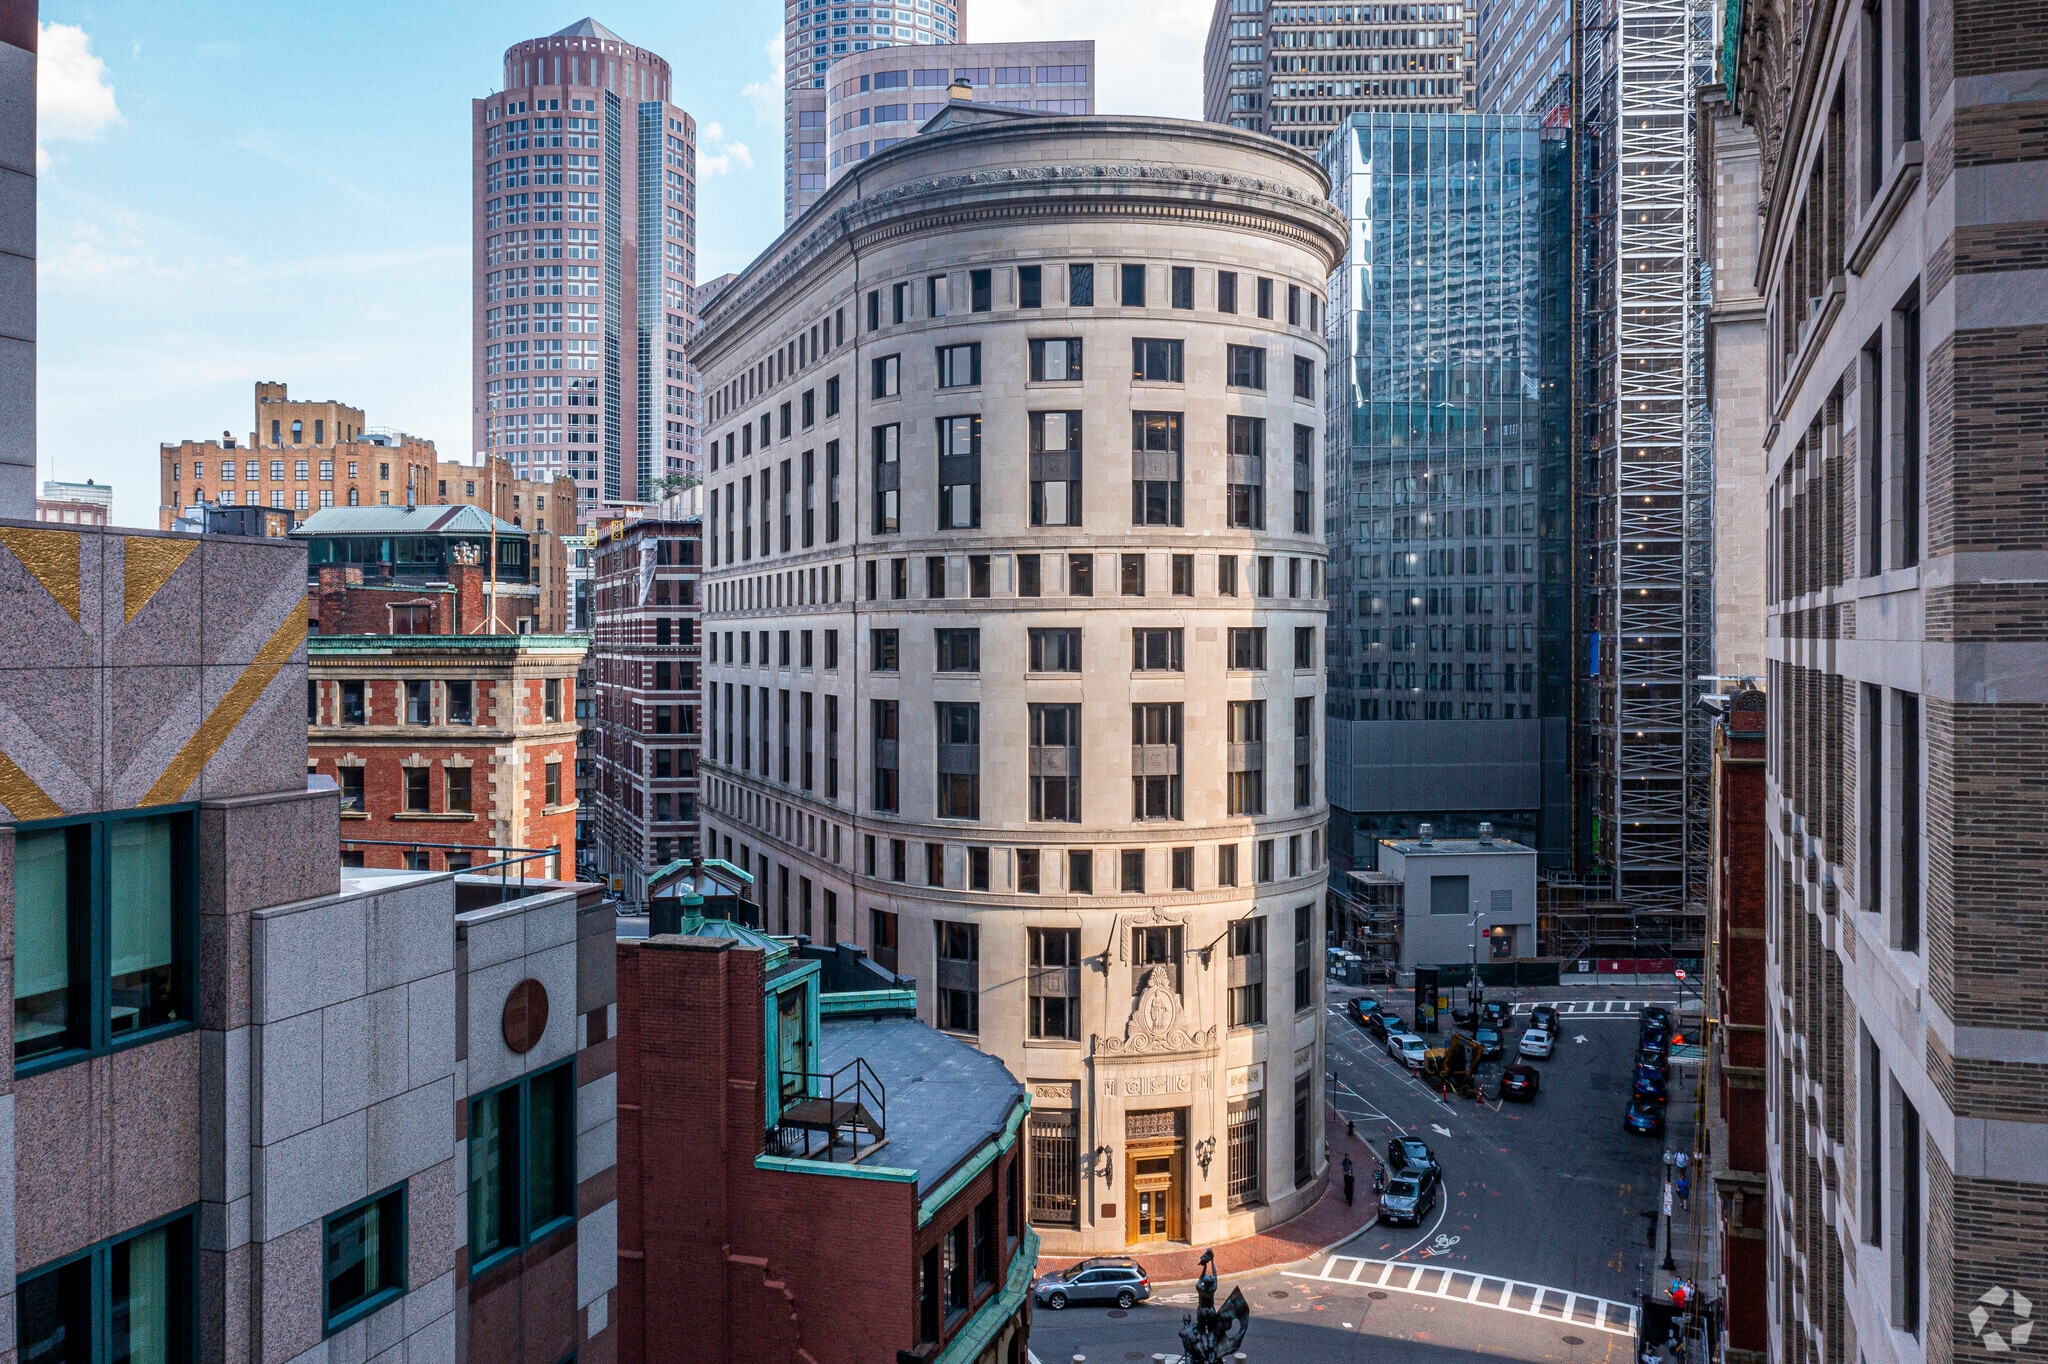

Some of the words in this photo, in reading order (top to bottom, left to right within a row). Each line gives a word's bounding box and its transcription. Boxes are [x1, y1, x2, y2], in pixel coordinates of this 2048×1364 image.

[1090, 897, 1126, 905] SAMUEL
[1130, 895, 1176, 905] APPLETON
[1180, 892, 1222, 902] BUILDING
